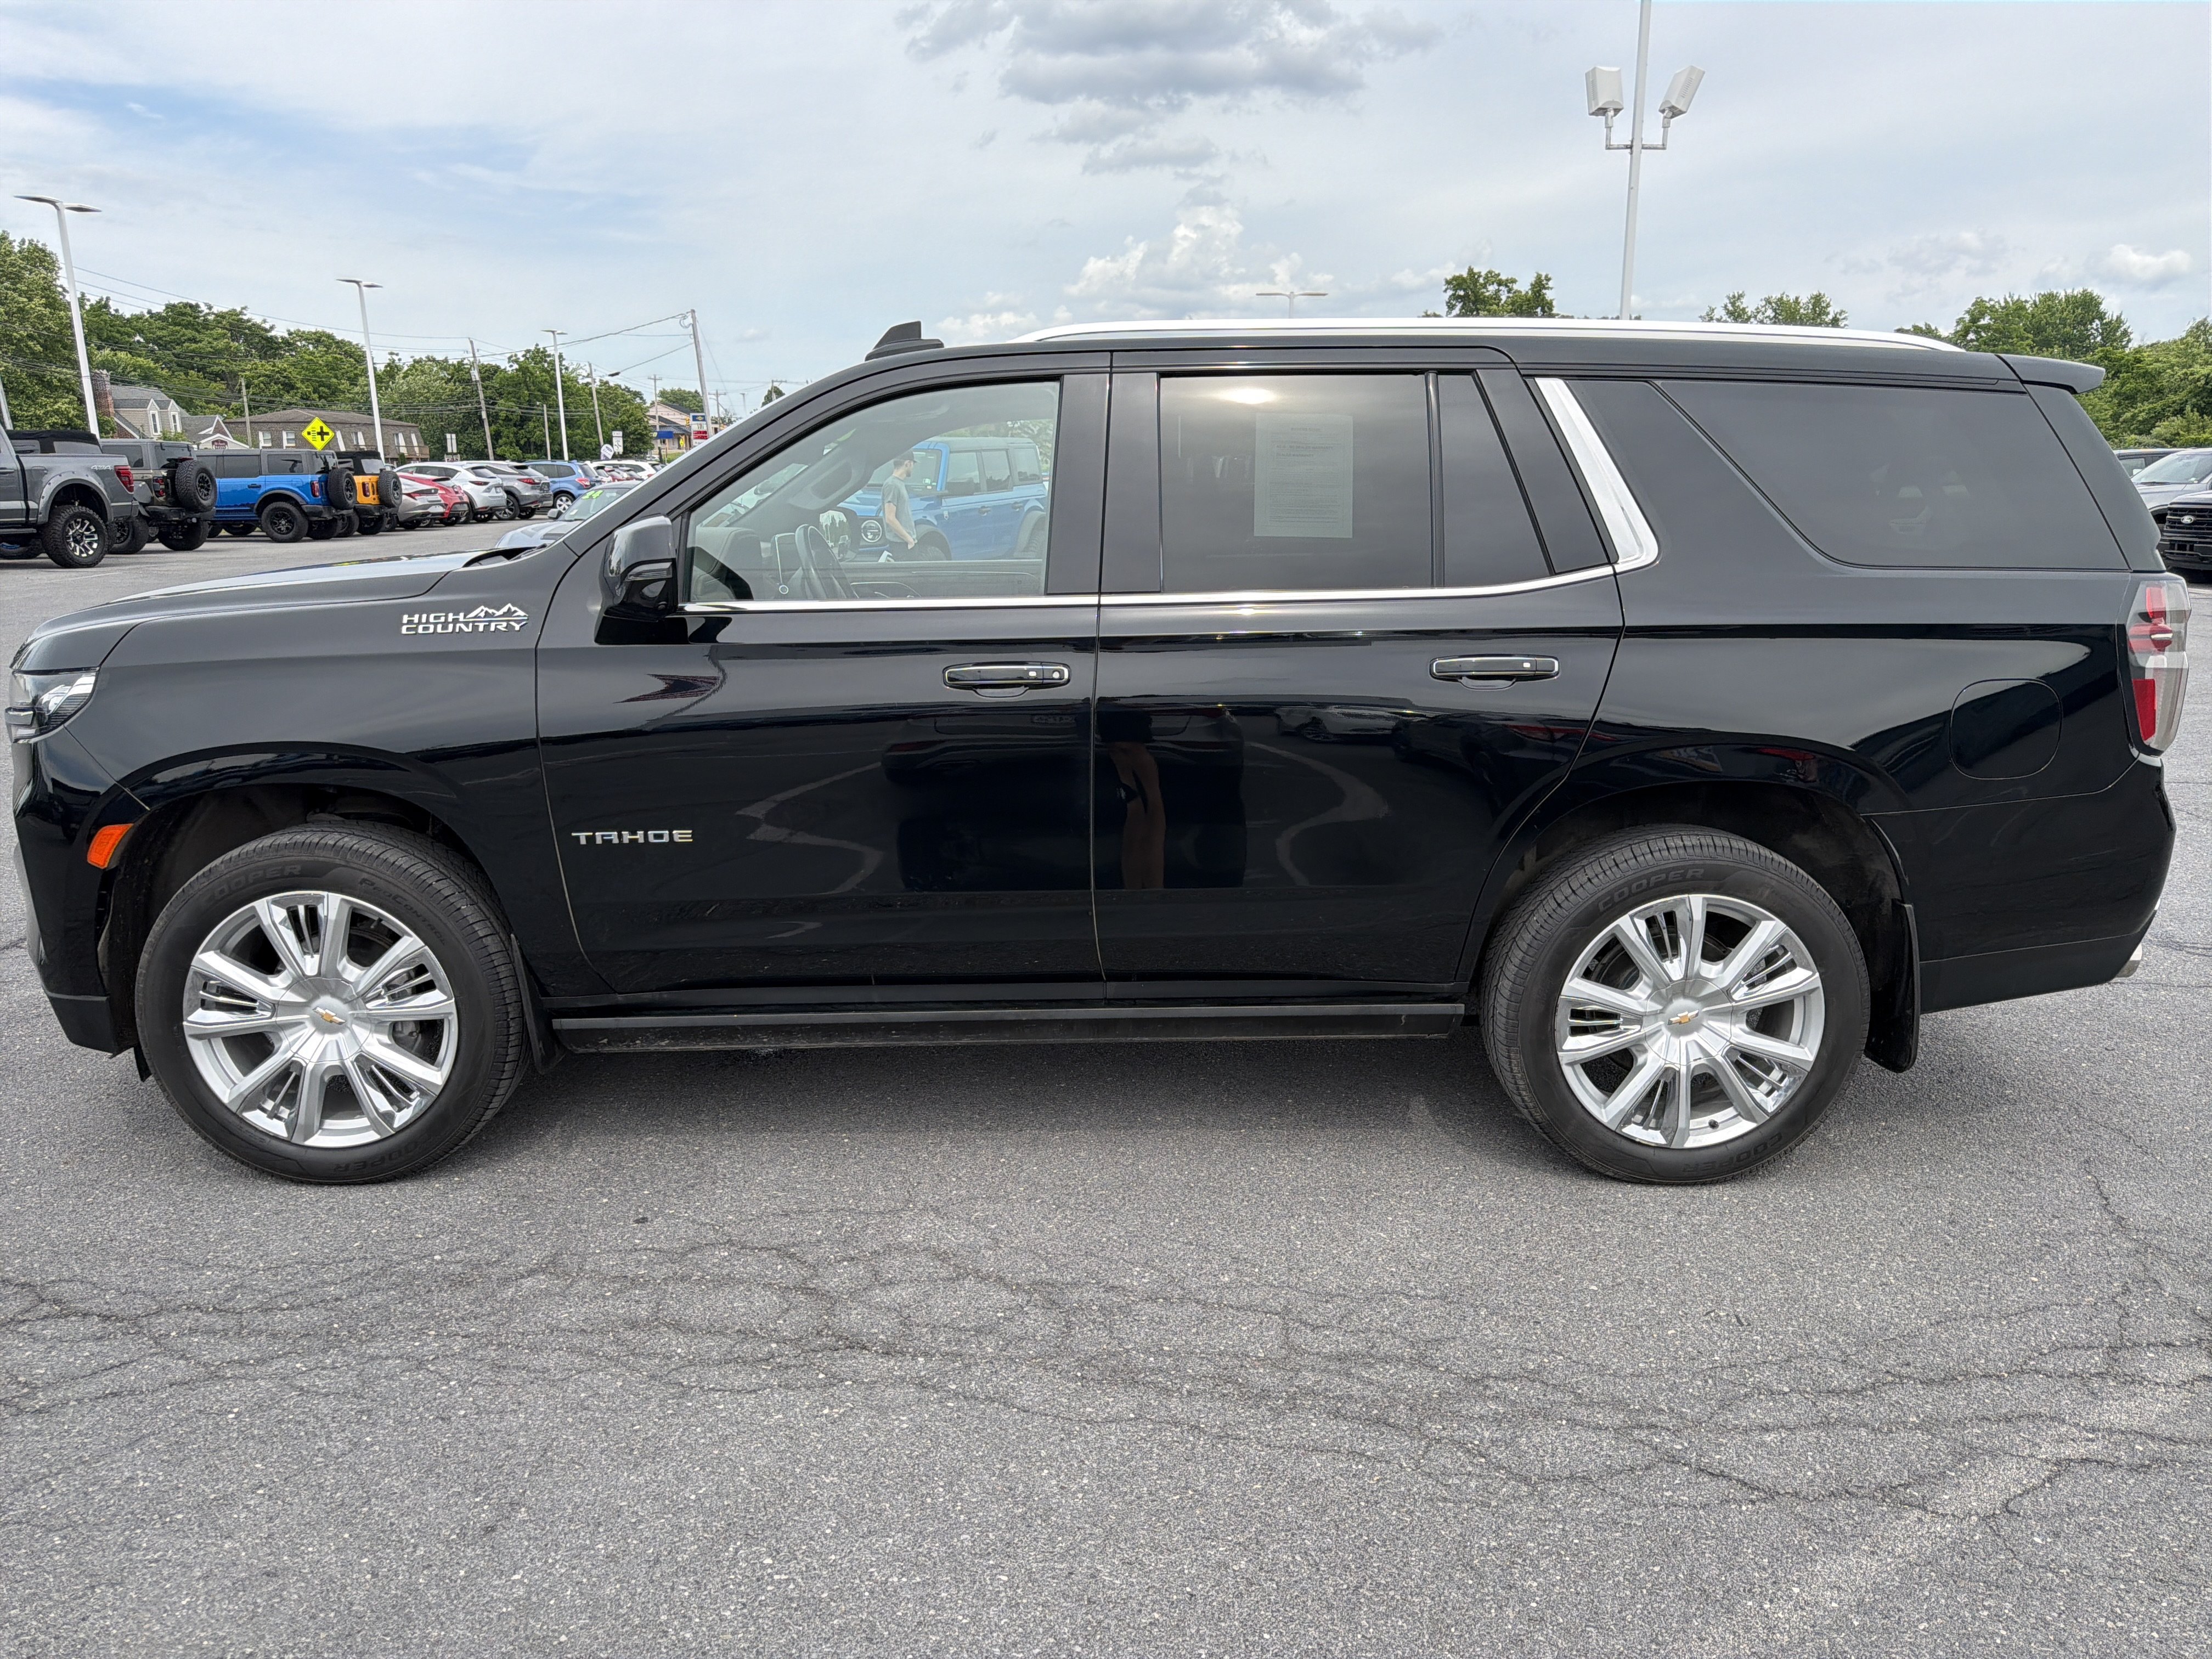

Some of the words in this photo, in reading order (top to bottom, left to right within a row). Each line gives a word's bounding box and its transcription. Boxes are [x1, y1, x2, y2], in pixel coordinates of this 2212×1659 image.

[401, 621, 529, 635] COUNTRY
[403, 612, 465, 624] HIGH
[571, 830, 693, 845] TAHOE
[1598, 868, 1705, 912] COOPER
[333, 1136, 429, 1172] OOPER
[1682, 1132, 1783, 1172] COOPER
